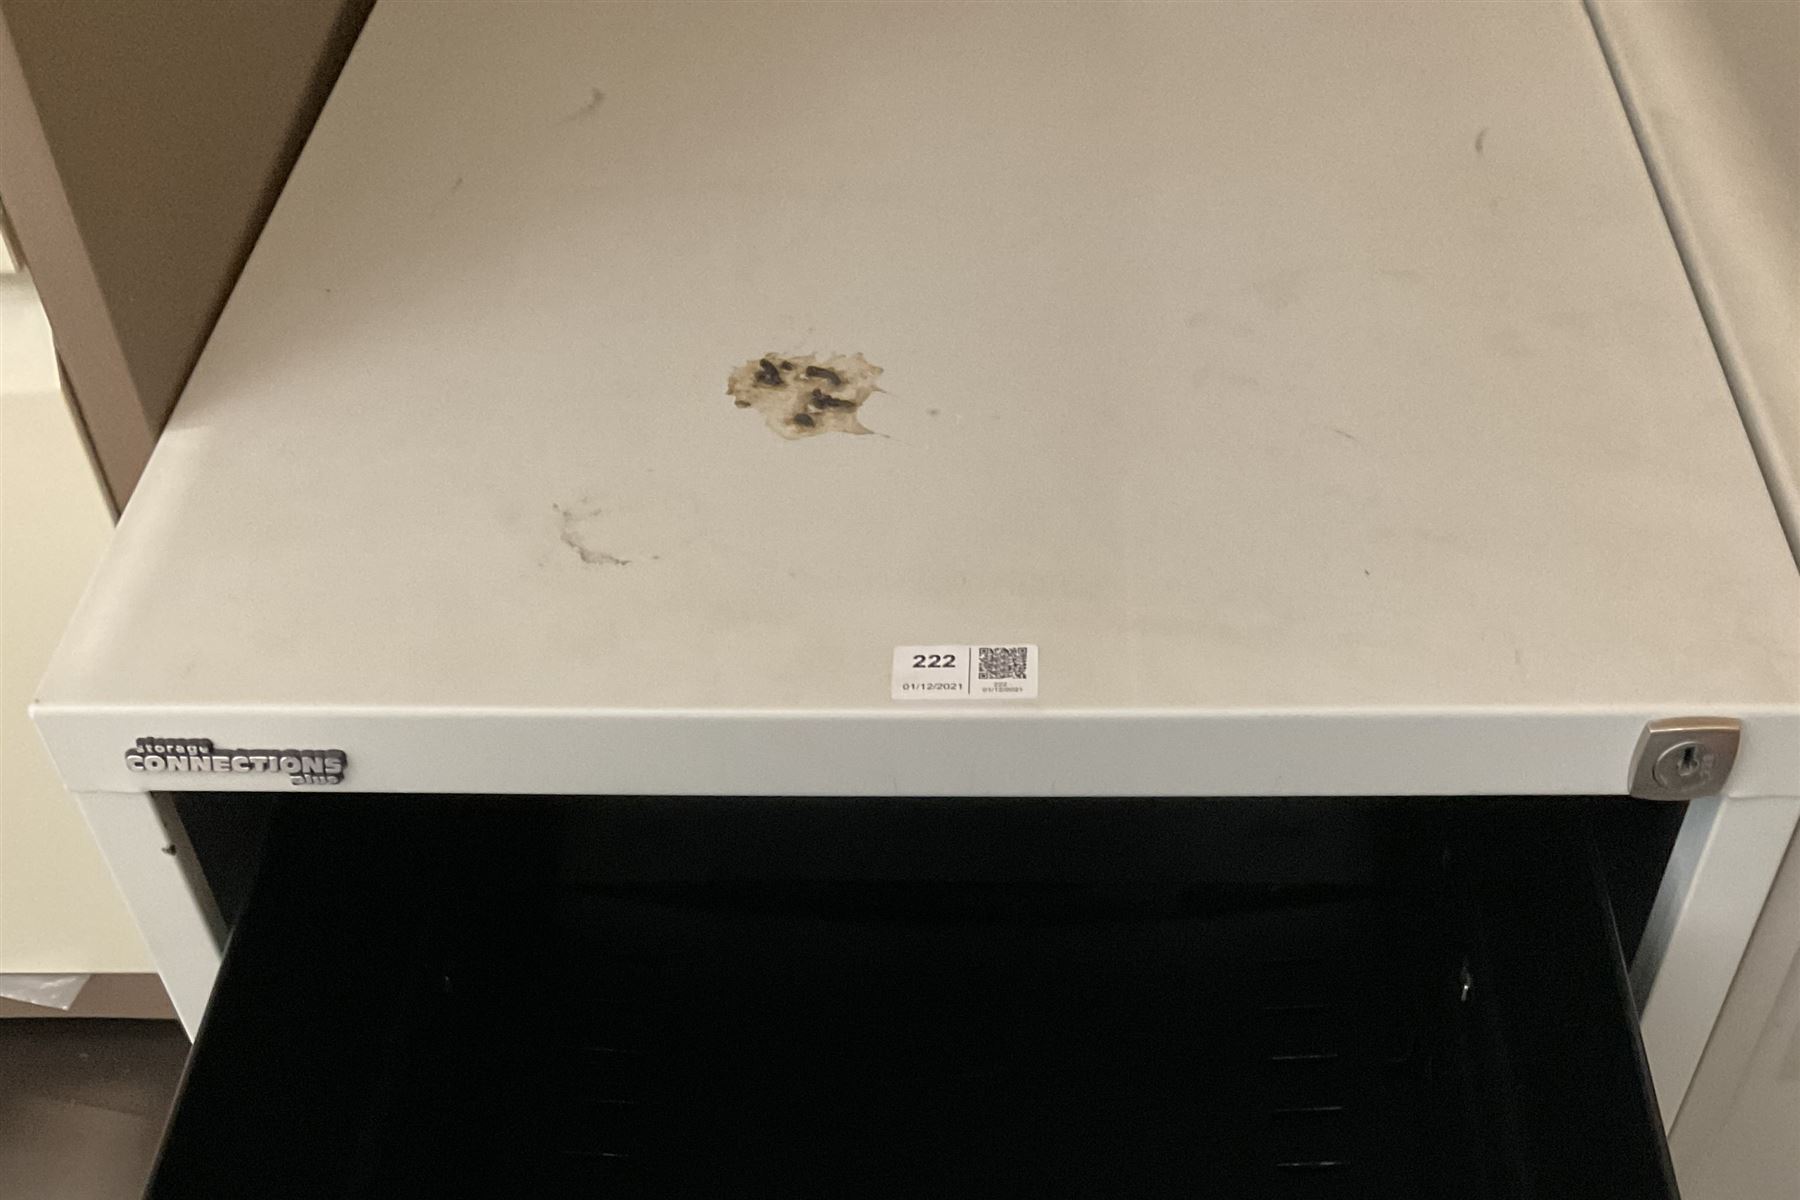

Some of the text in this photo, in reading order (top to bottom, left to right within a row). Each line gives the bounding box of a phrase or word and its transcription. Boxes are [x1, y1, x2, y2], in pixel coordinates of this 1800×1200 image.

[912, 654, 956, 668] 222
[902, 683, 963, 691] 01/12/2021
[136, 743, 209, 755] storage
[126, 754, 342, 774] CONNECTIONS
